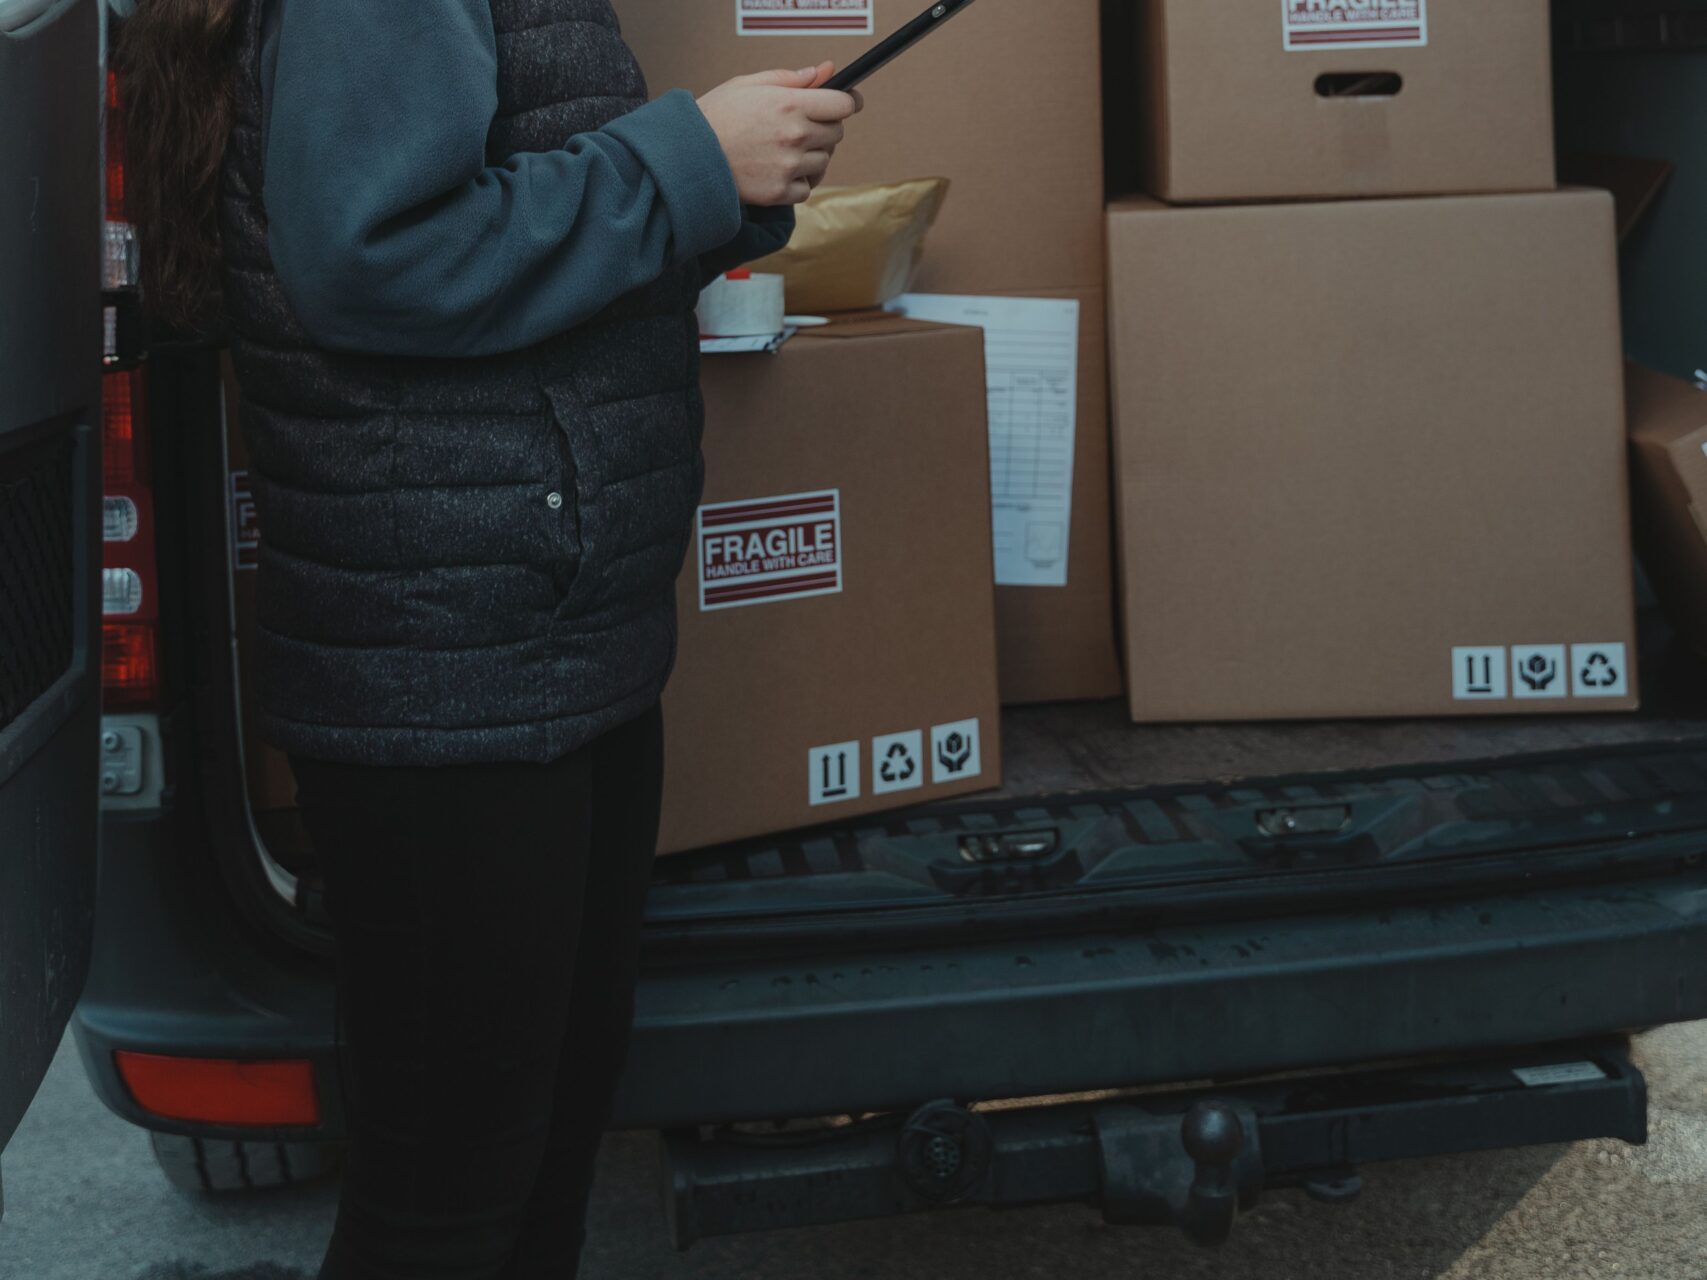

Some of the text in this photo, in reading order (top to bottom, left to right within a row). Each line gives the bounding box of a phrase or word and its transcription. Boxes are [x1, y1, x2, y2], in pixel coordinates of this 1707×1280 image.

[705, 523, 833, 566] FRAGILE
[706, 549, 834, 579] HANDLE WITH CARE
